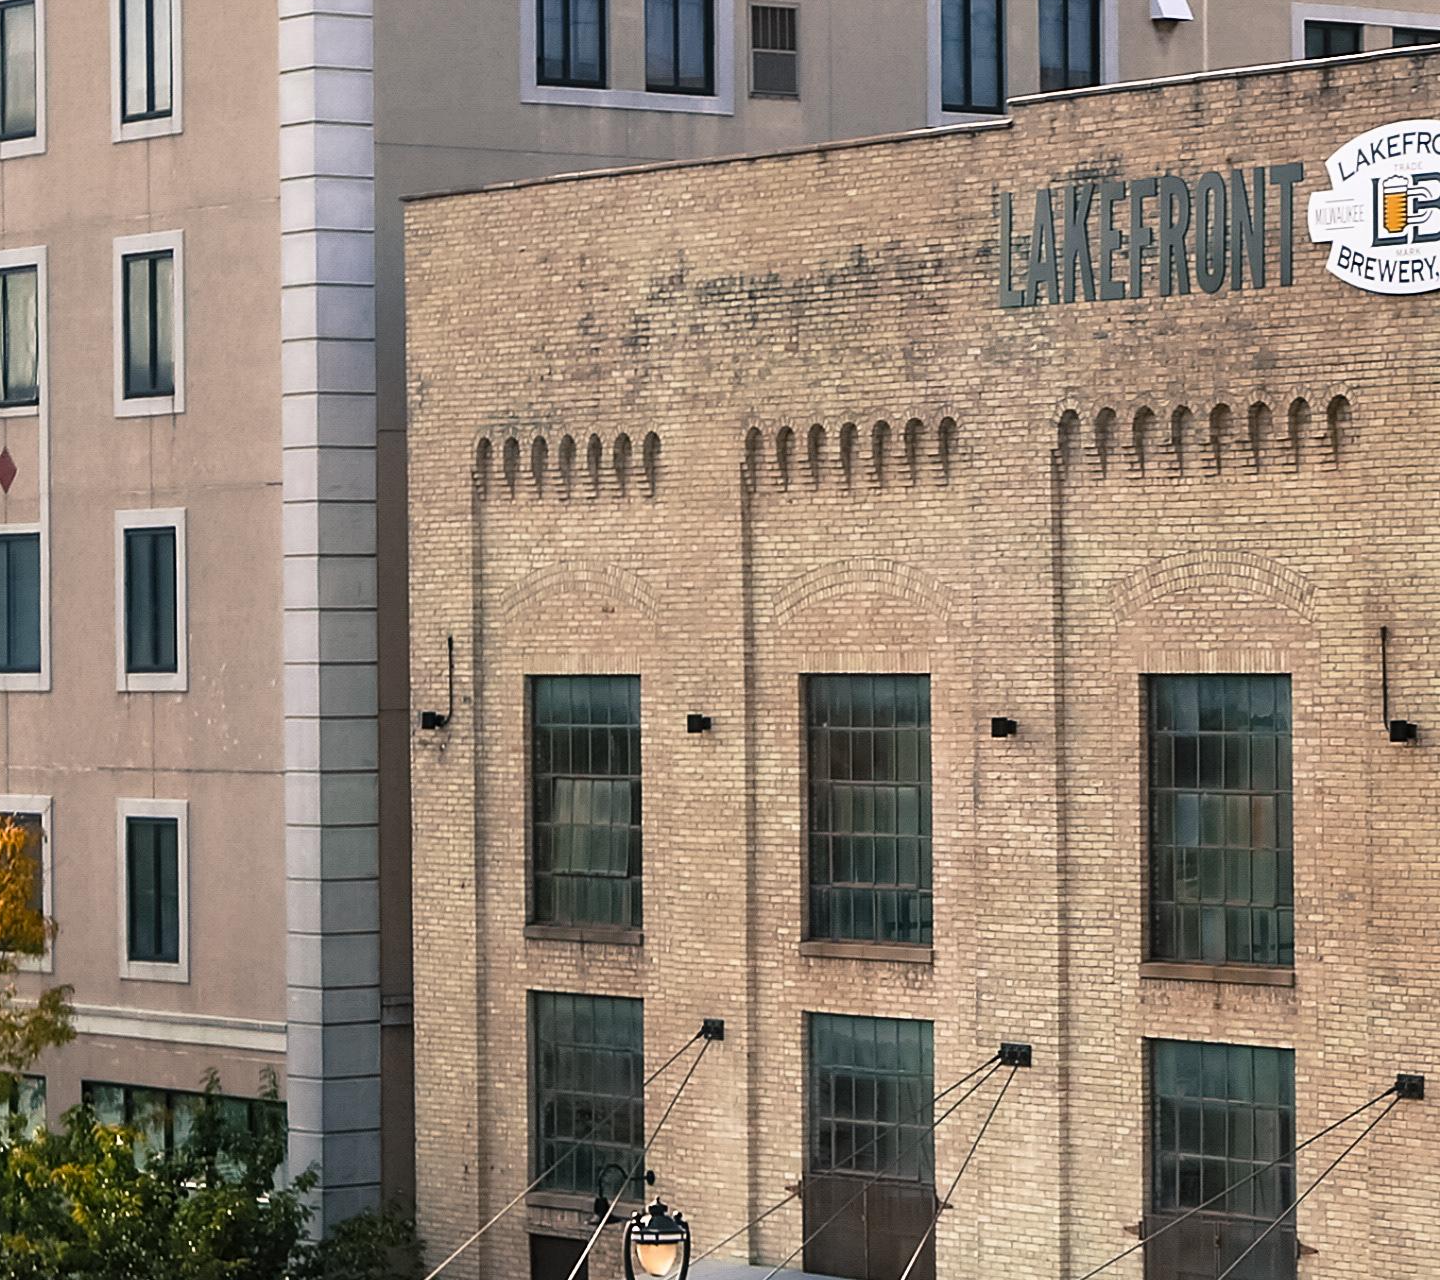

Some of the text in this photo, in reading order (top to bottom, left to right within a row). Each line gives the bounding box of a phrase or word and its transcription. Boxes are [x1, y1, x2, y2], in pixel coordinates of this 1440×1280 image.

[1394, 161, 1423, 171] TRADE
[1315, 204, 1365, 225] MILWAUKEE
[999, 162, 1304, 308] LAKEFRONT
[1396, 248, 1421, 257] MARK
[1337, 245, 1440, 283] BREWERY,
